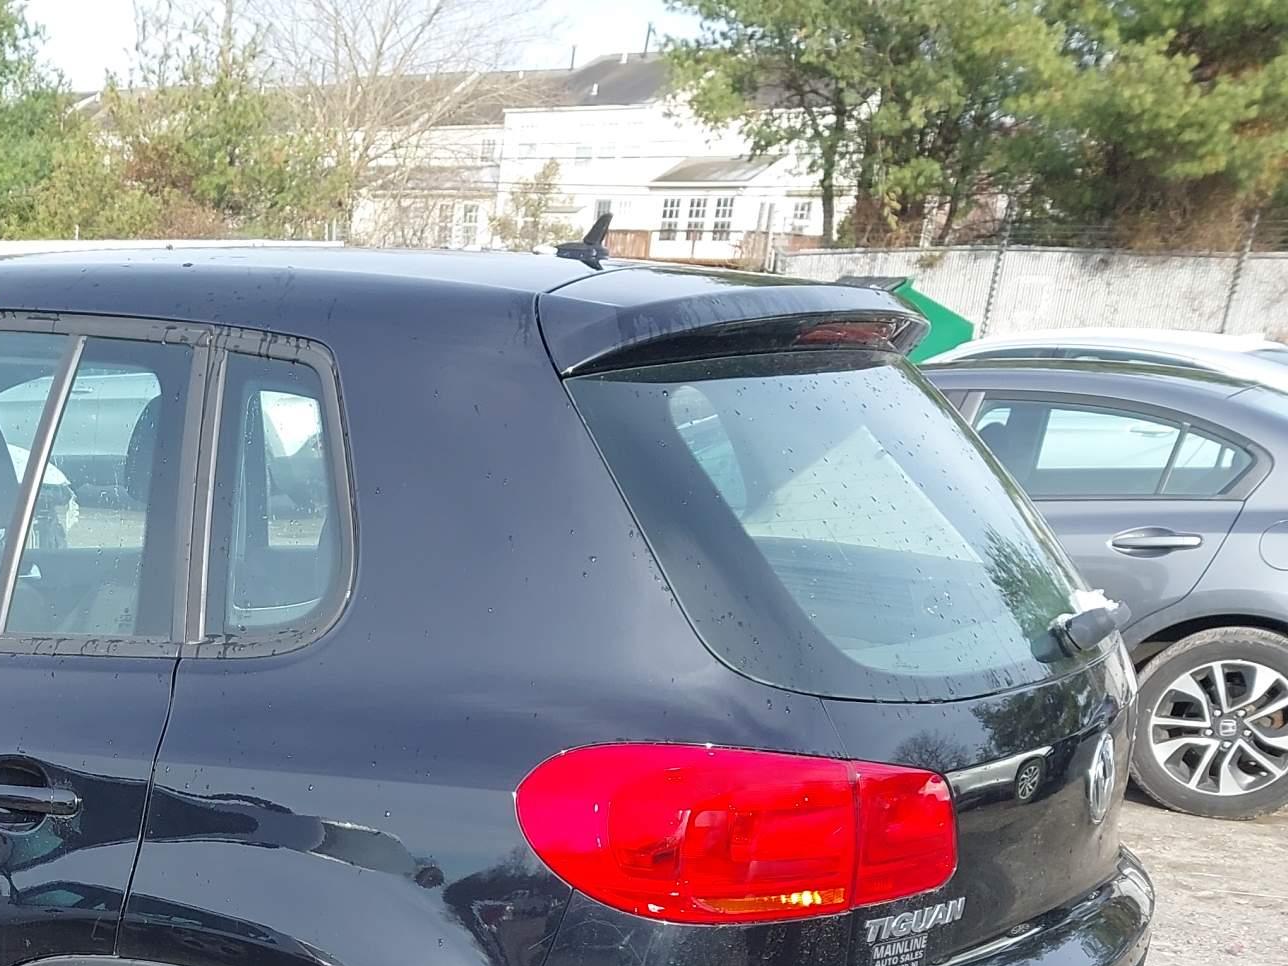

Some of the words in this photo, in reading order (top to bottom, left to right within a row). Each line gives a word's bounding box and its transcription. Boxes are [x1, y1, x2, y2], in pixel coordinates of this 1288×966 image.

[865, 896, 966, 943] TIGUAN
[873, 935, 928, 960] MAINLINE
[900, 950, 924, 963] SALES
